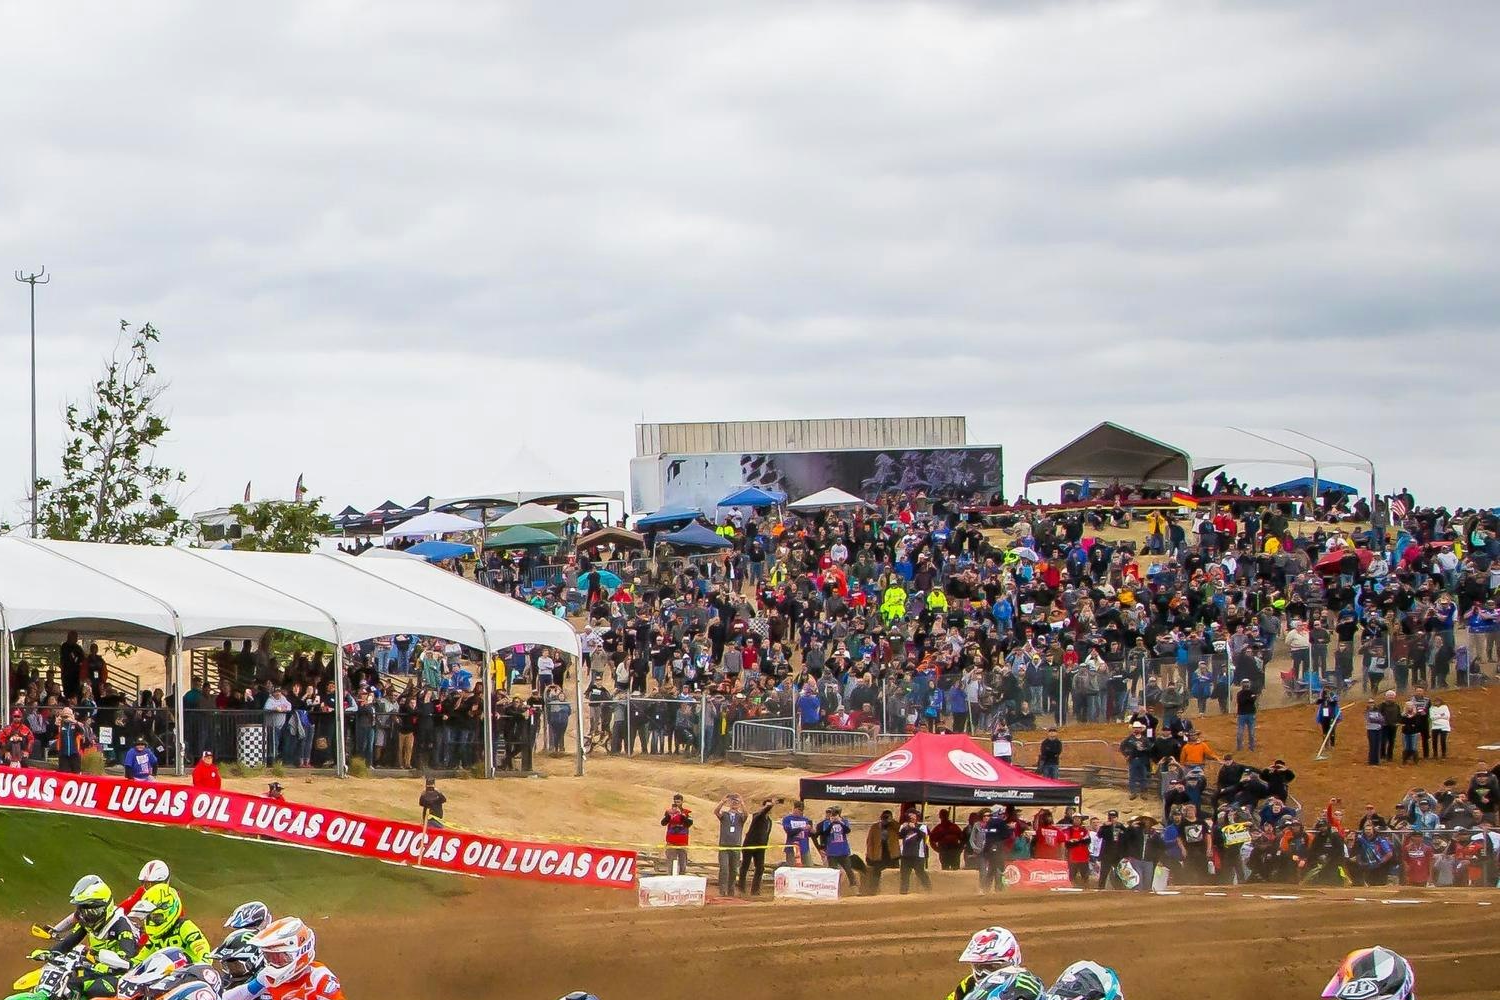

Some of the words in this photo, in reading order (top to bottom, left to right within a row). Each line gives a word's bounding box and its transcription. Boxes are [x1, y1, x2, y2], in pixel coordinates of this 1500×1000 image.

[60, 780, 97, 809] OIL
[107, 785, 188, 817] LUCAS
[192, 793, 230, 823] OIL
[826, 784, 895, 795] HangtownMX.com
[973, 788, 1034, 800] HangtownMX.com
[241, 801, 324, 839] LUCAS
[326, 817, 366, 847] OIL
[376, 826, 461, 863] LUCAS
[463, 841, 502, 870] OIL
[501, 847, 593, 878] LUCAS
[595, 855, 634, 882] OIL
